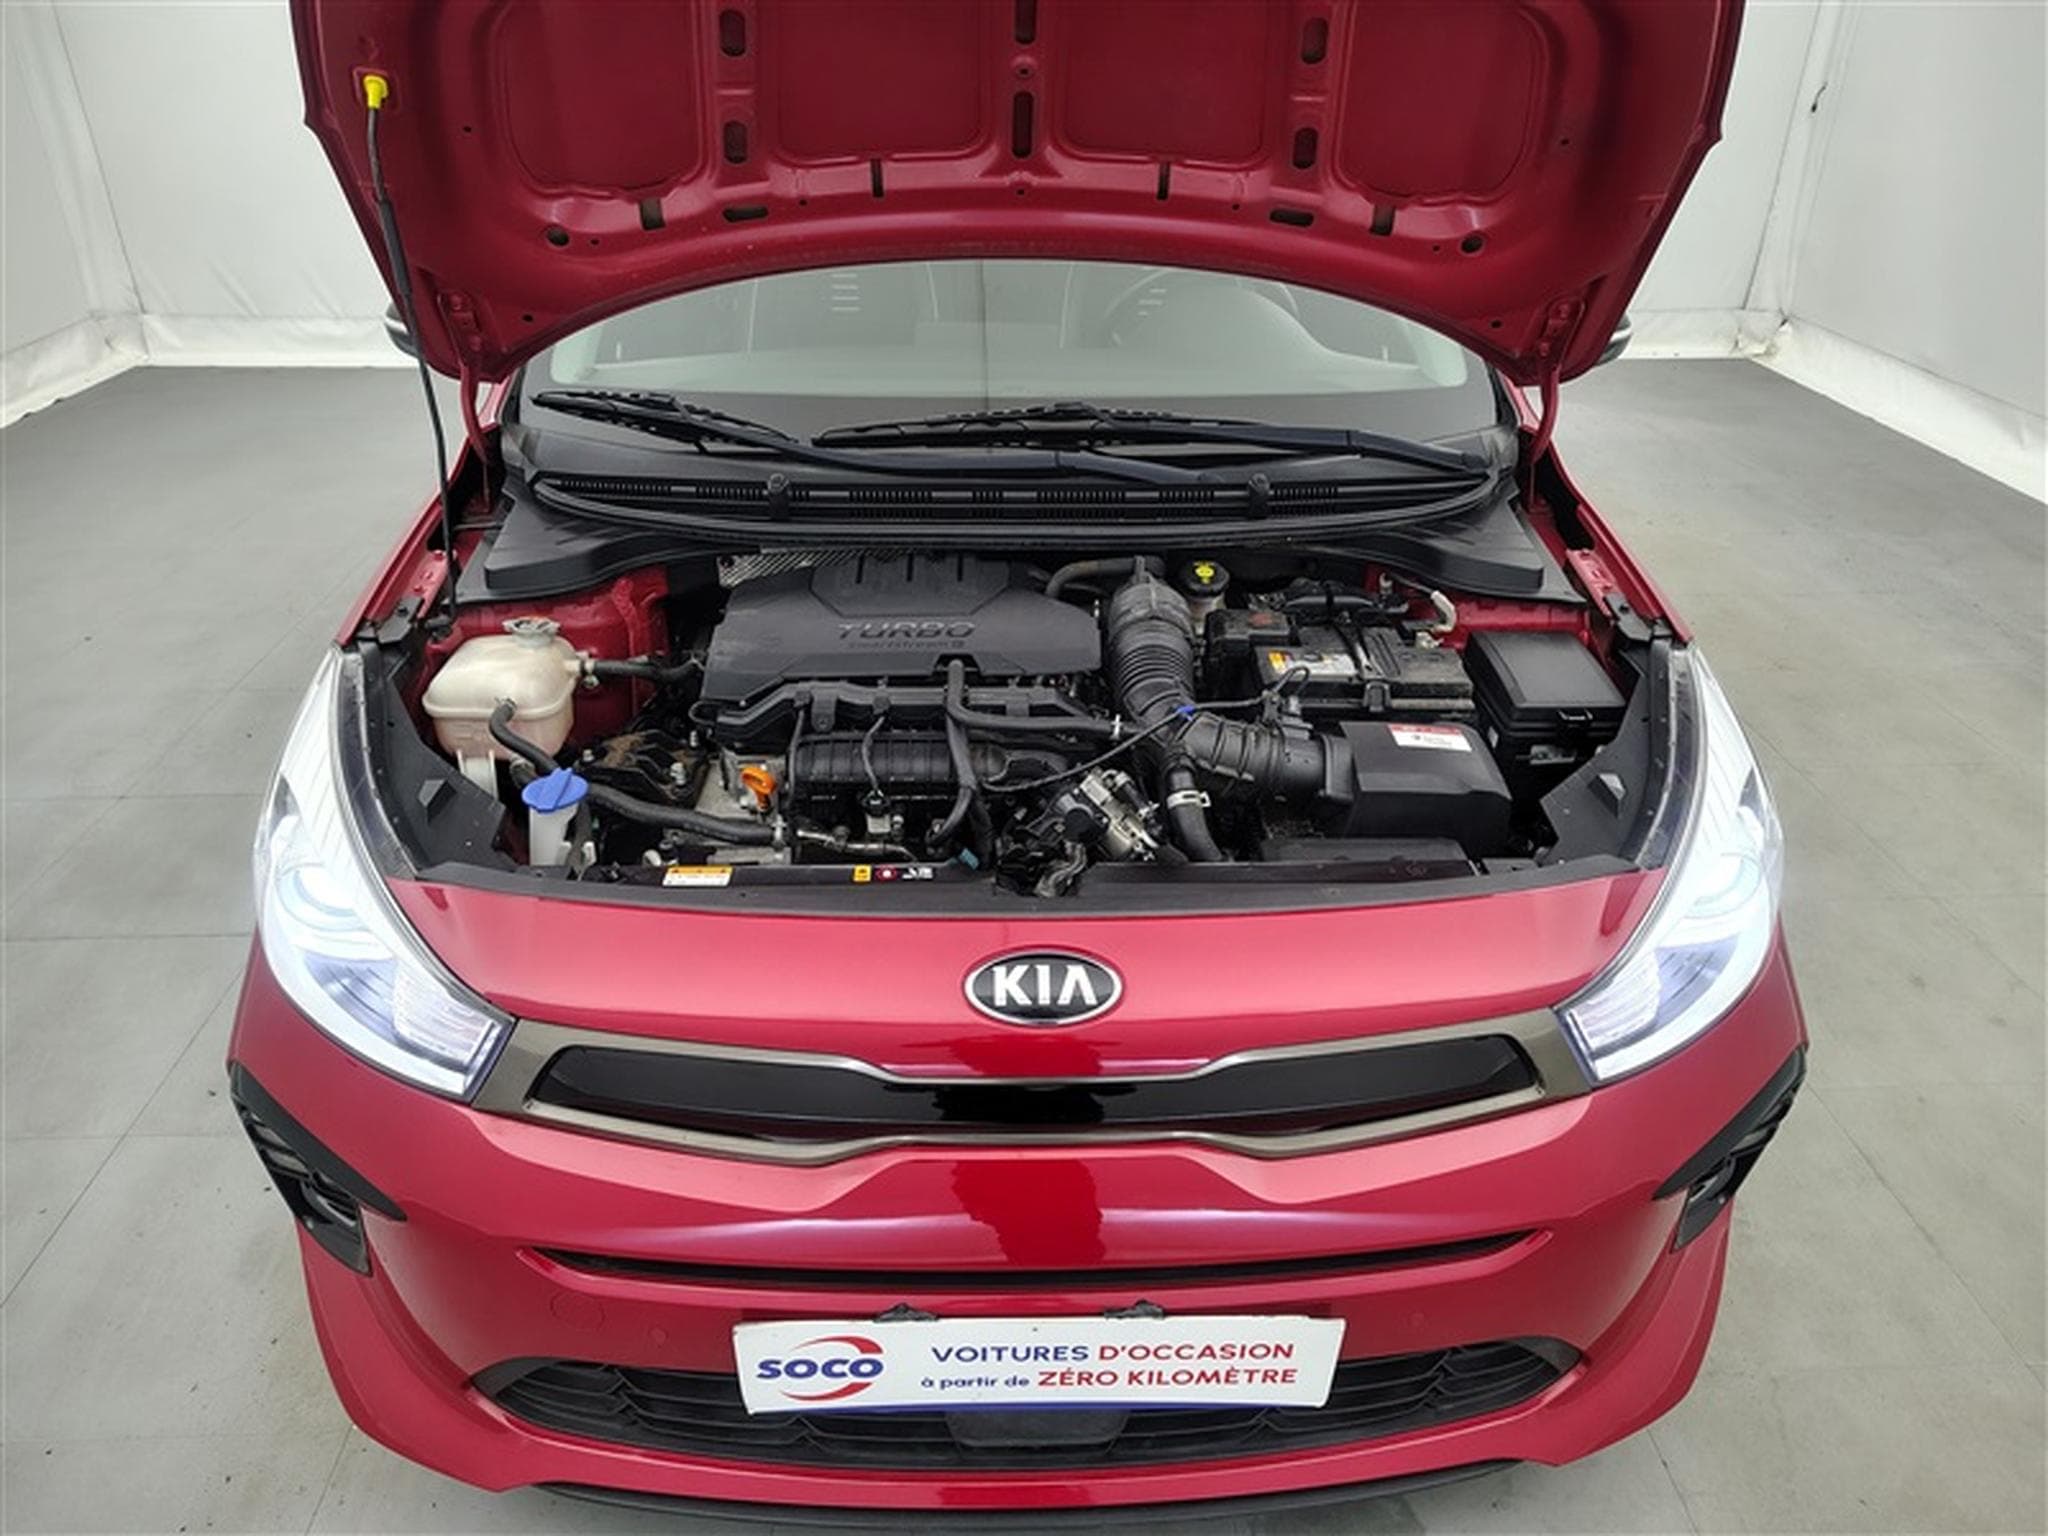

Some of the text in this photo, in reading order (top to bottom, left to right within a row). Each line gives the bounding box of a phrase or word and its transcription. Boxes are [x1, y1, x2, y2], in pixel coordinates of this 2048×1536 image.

[838, 621, 976, 639] TURBO
[991, 964, 1099, 1007] KIA
[931, 1343, 1295, 1363] VOITURES D'OCCASION
[755, 1358, 885, 1379] SOCO
[920, 1366, 1298, 1391] à partir de ZÉRO KILOMÈTRE
